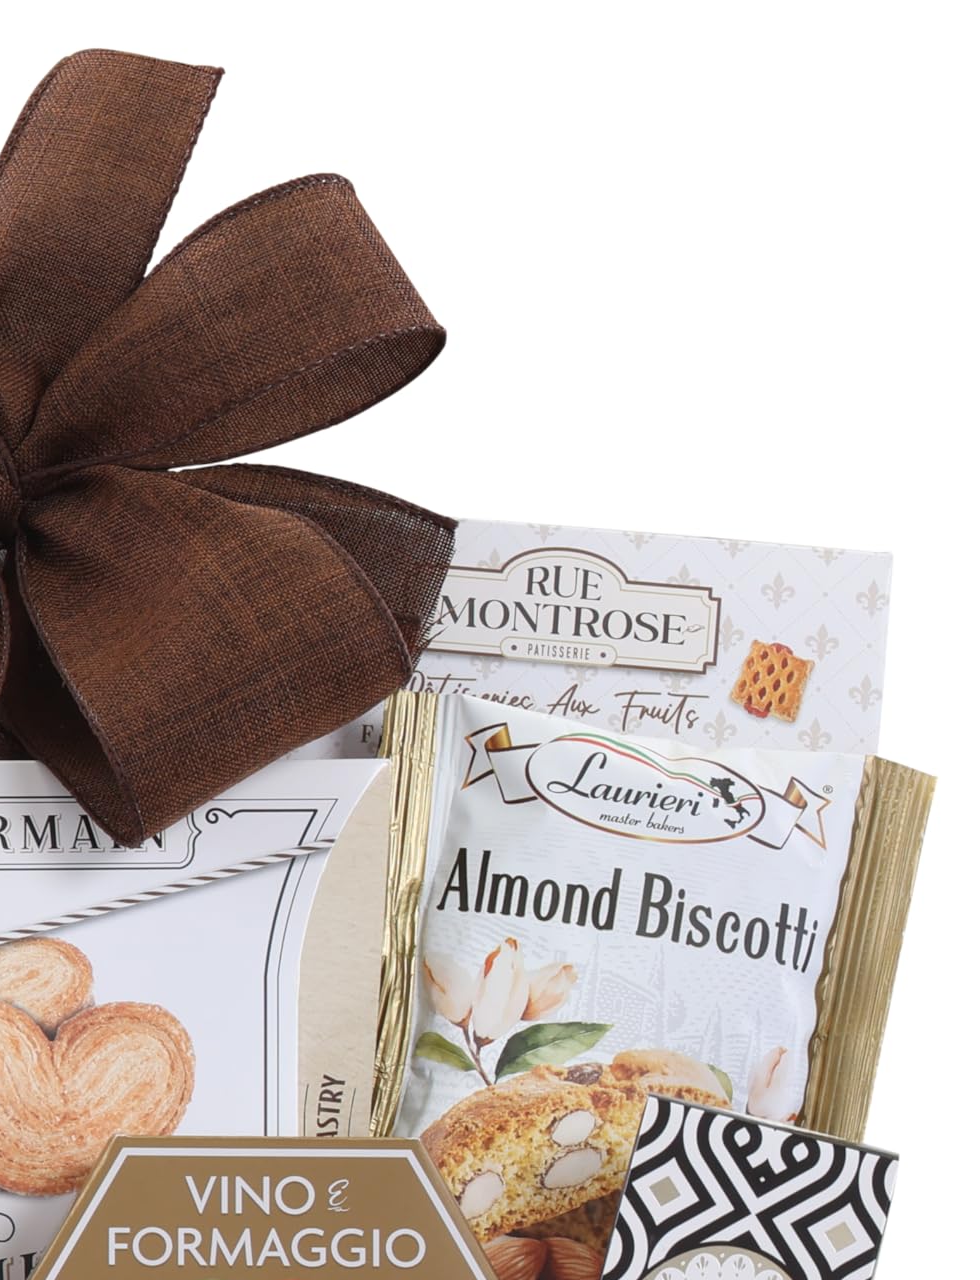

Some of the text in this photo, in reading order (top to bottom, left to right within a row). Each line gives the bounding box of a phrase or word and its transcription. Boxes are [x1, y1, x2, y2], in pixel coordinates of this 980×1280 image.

[525, 565, 603, 601] RUE
[435, 594, 687, 645] MONTROSE
[527, 643, 591, 660] PATISSERIE
[547, 683, 600, 717] Aux
[614, 690, 710, 734] Fruits
[546, 752, 701, 816] Laurieri
[599, 811, 685, 834] master bakers
[436, 847, 818, 974] Almond Biscotti
[185, 1175, 316, 1215] VINO
[107, 1226, 427, 1269] FORMAGGIO
